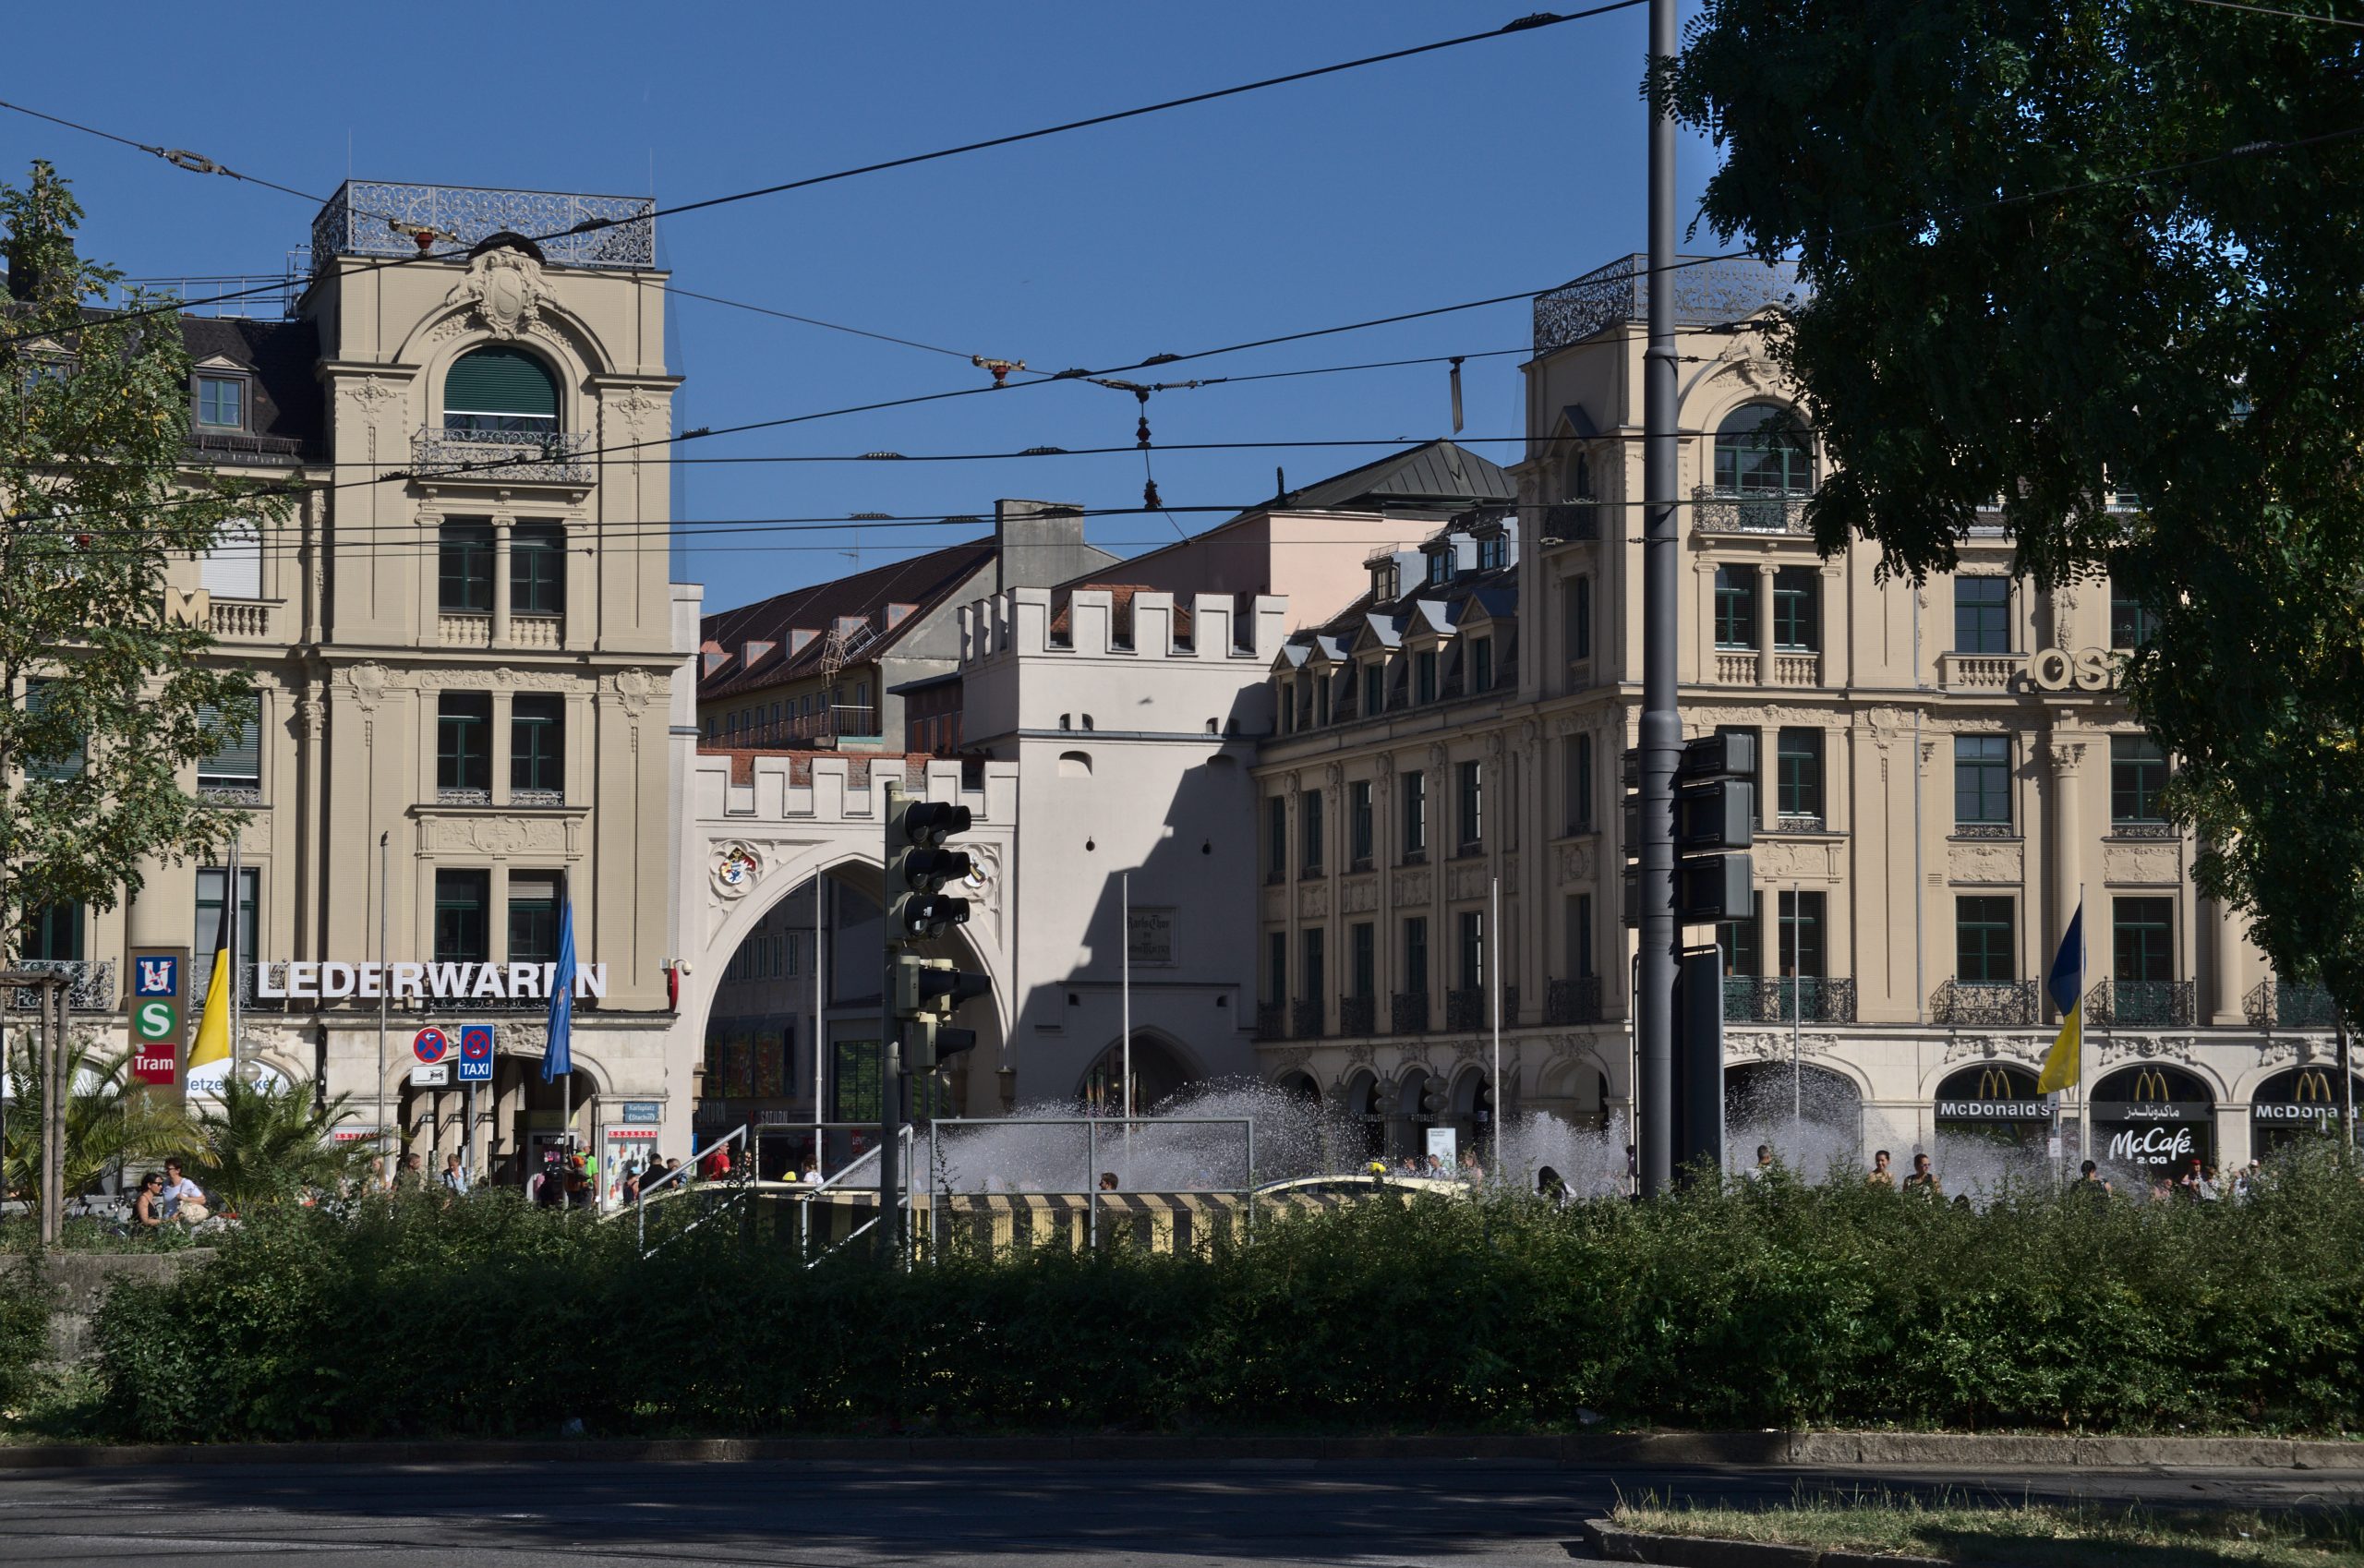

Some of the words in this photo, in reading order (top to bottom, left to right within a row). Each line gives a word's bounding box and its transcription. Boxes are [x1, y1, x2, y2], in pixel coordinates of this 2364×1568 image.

[142, 1004, 171, 1037] S
[135, 1055, 175, 1071] Tram
[463, 1063, 488, 1076] TAXI
[1940, 1103, 2050, 1116] McDonald's
[2124, 1104, 2179, 1120] ماكدونالدز
